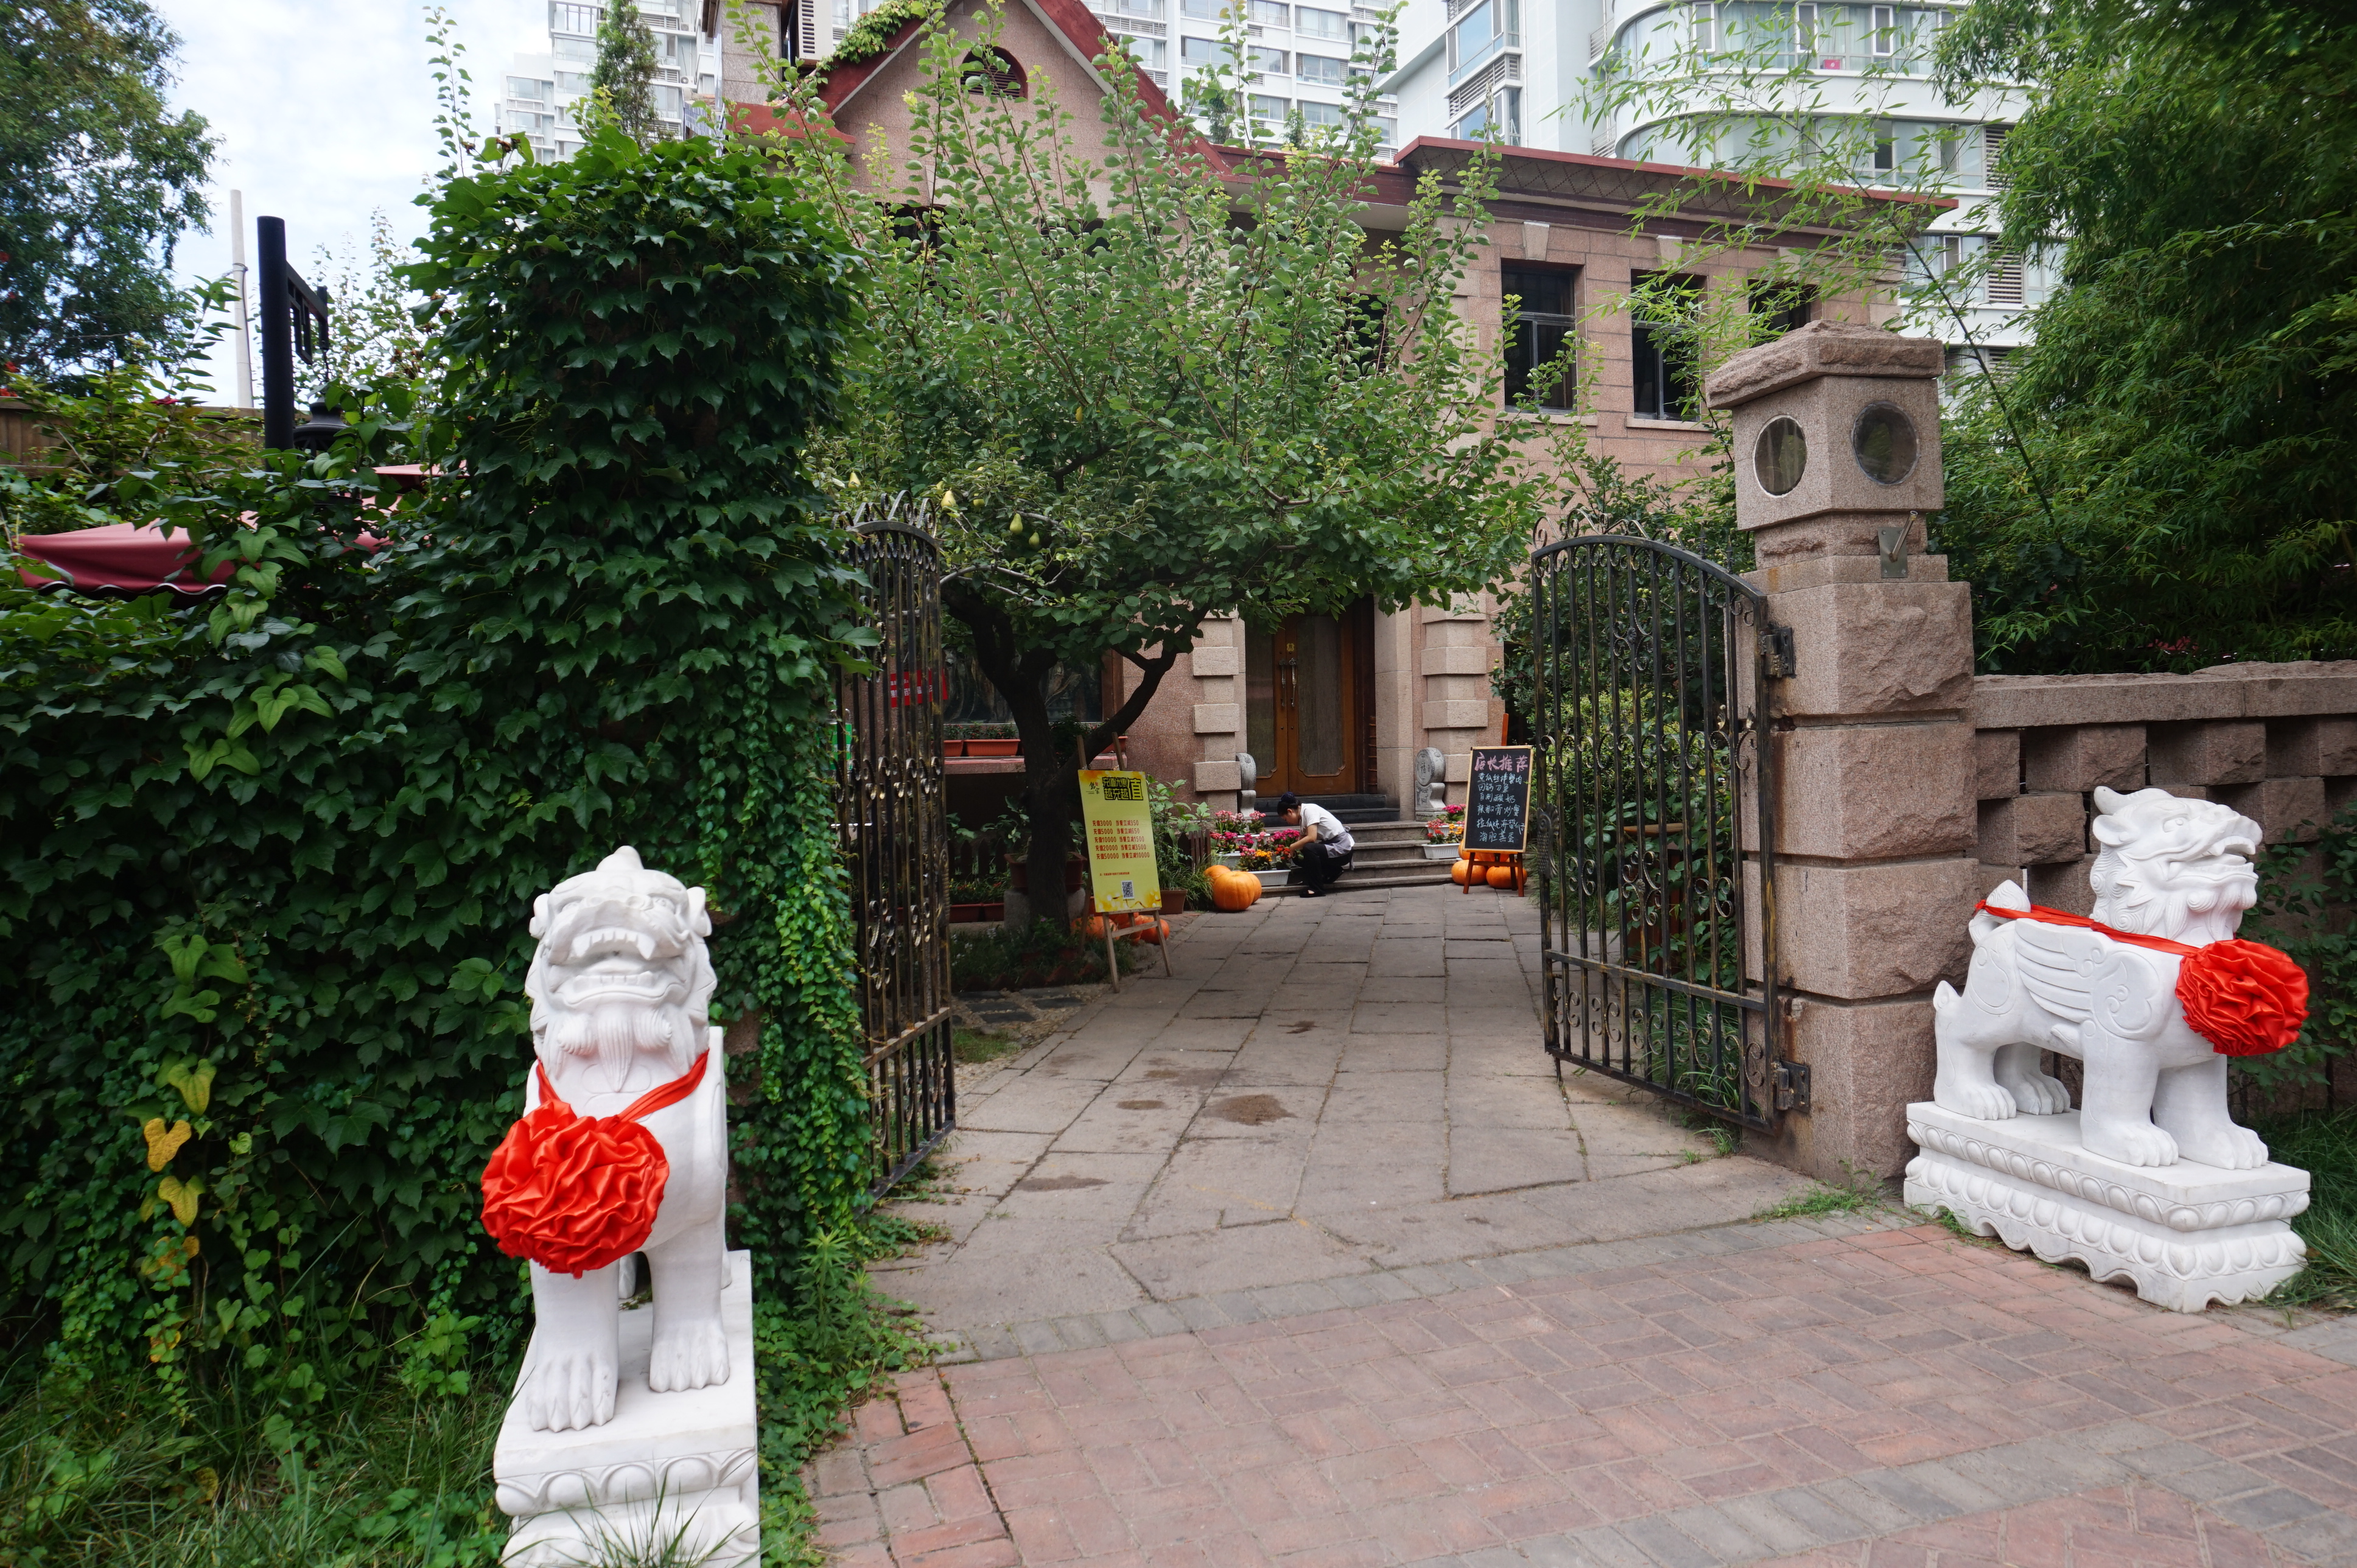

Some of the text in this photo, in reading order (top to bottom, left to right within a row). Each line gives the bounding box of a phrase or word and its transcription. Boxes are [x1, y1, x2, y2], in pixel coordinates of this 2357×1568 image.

[1474, 752, 1528, 772] 店长推荐
[1480, 793, 1516, 803] 自制酸奶
